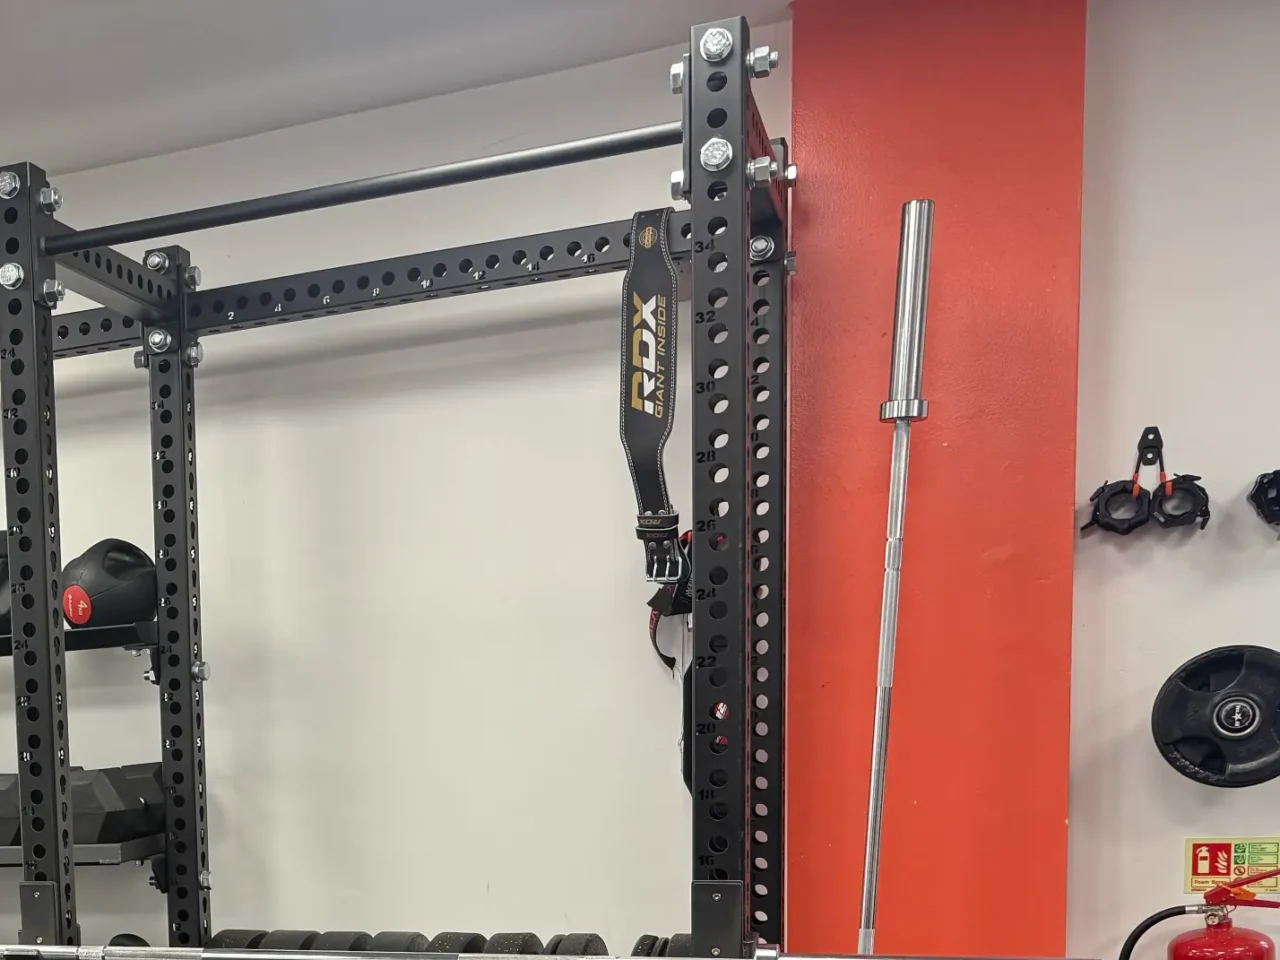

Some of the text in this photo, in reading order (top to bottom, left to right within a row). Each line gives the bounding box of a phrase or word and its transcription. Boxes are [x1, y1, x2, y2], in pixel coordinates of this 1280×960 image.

[694, 239, 716, 253] 34
[695, 310, 716, 324] 32
[631, 291, 656, 414] RDX
[655, 294, 666, 418] GIANT INSIDE
[696, 381, 715, 394] 30
[696, 450, 716, 463] 28
[697, 520, 716, 532] 26
[697, 588, 716, 600] 24
[697, 656, 717, 668] 22
[697, 723, 716, 735] 20
[697, 855, 715, 867] 16
